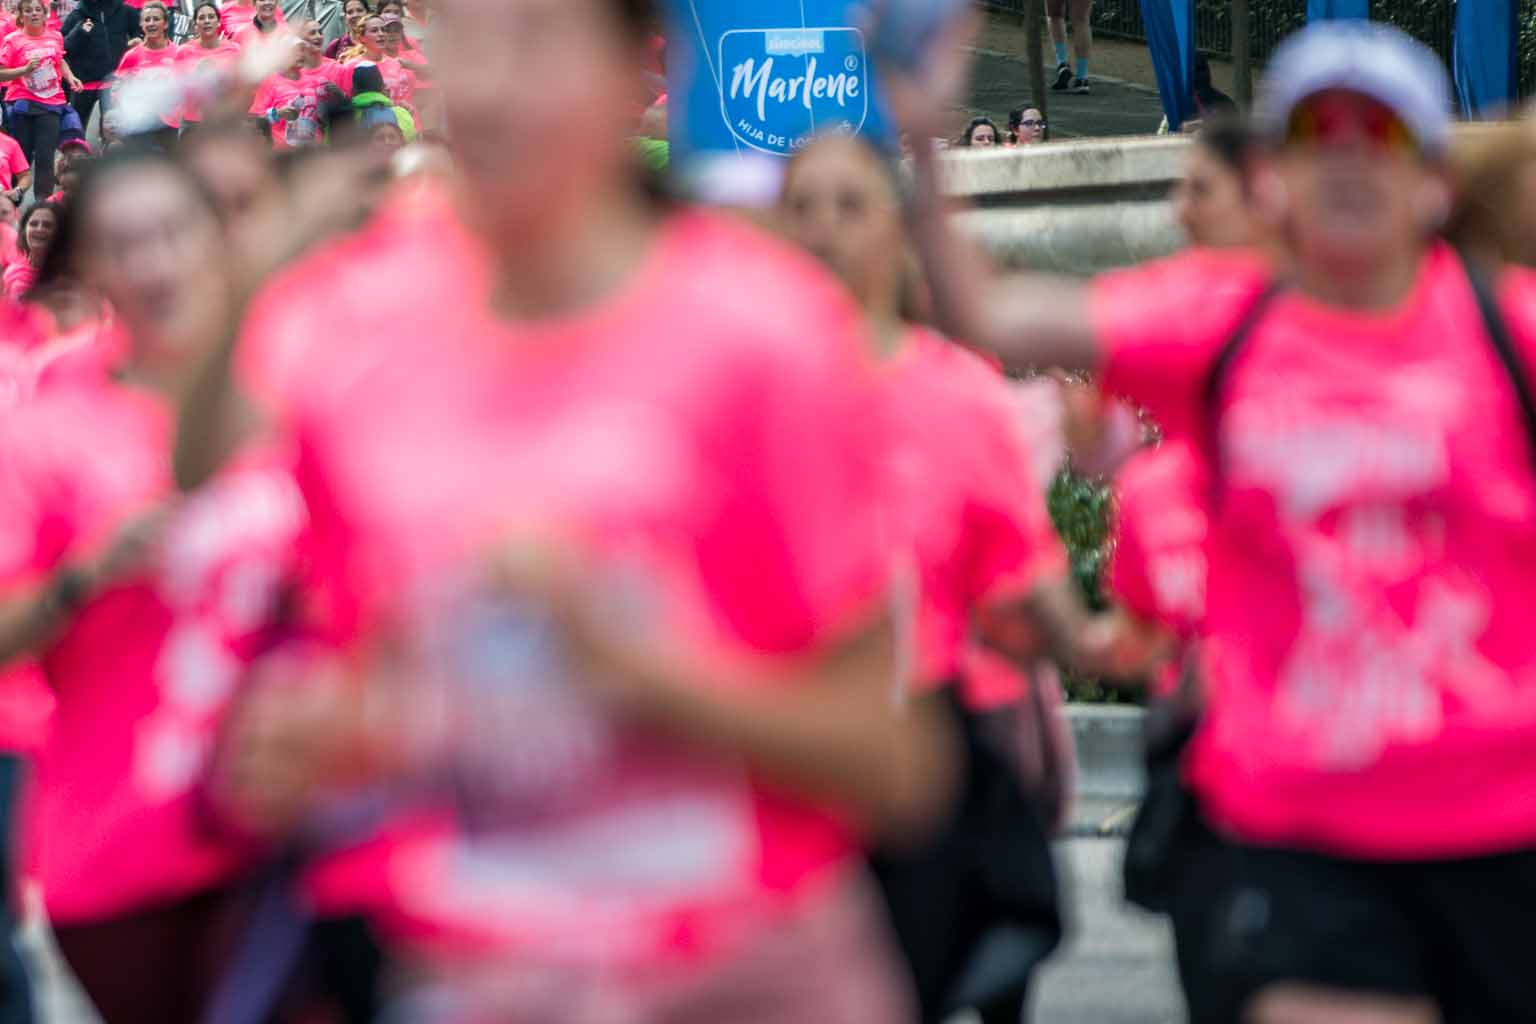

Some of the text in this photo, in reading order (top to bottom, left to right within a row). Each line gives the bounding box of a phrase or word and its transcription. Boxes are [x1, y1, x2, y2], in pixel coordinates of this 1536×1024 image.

[730, 56, 859, 122] Marlene
[738, 119, 763, 141] HIJA
[767, 134, 785, 147] DE
